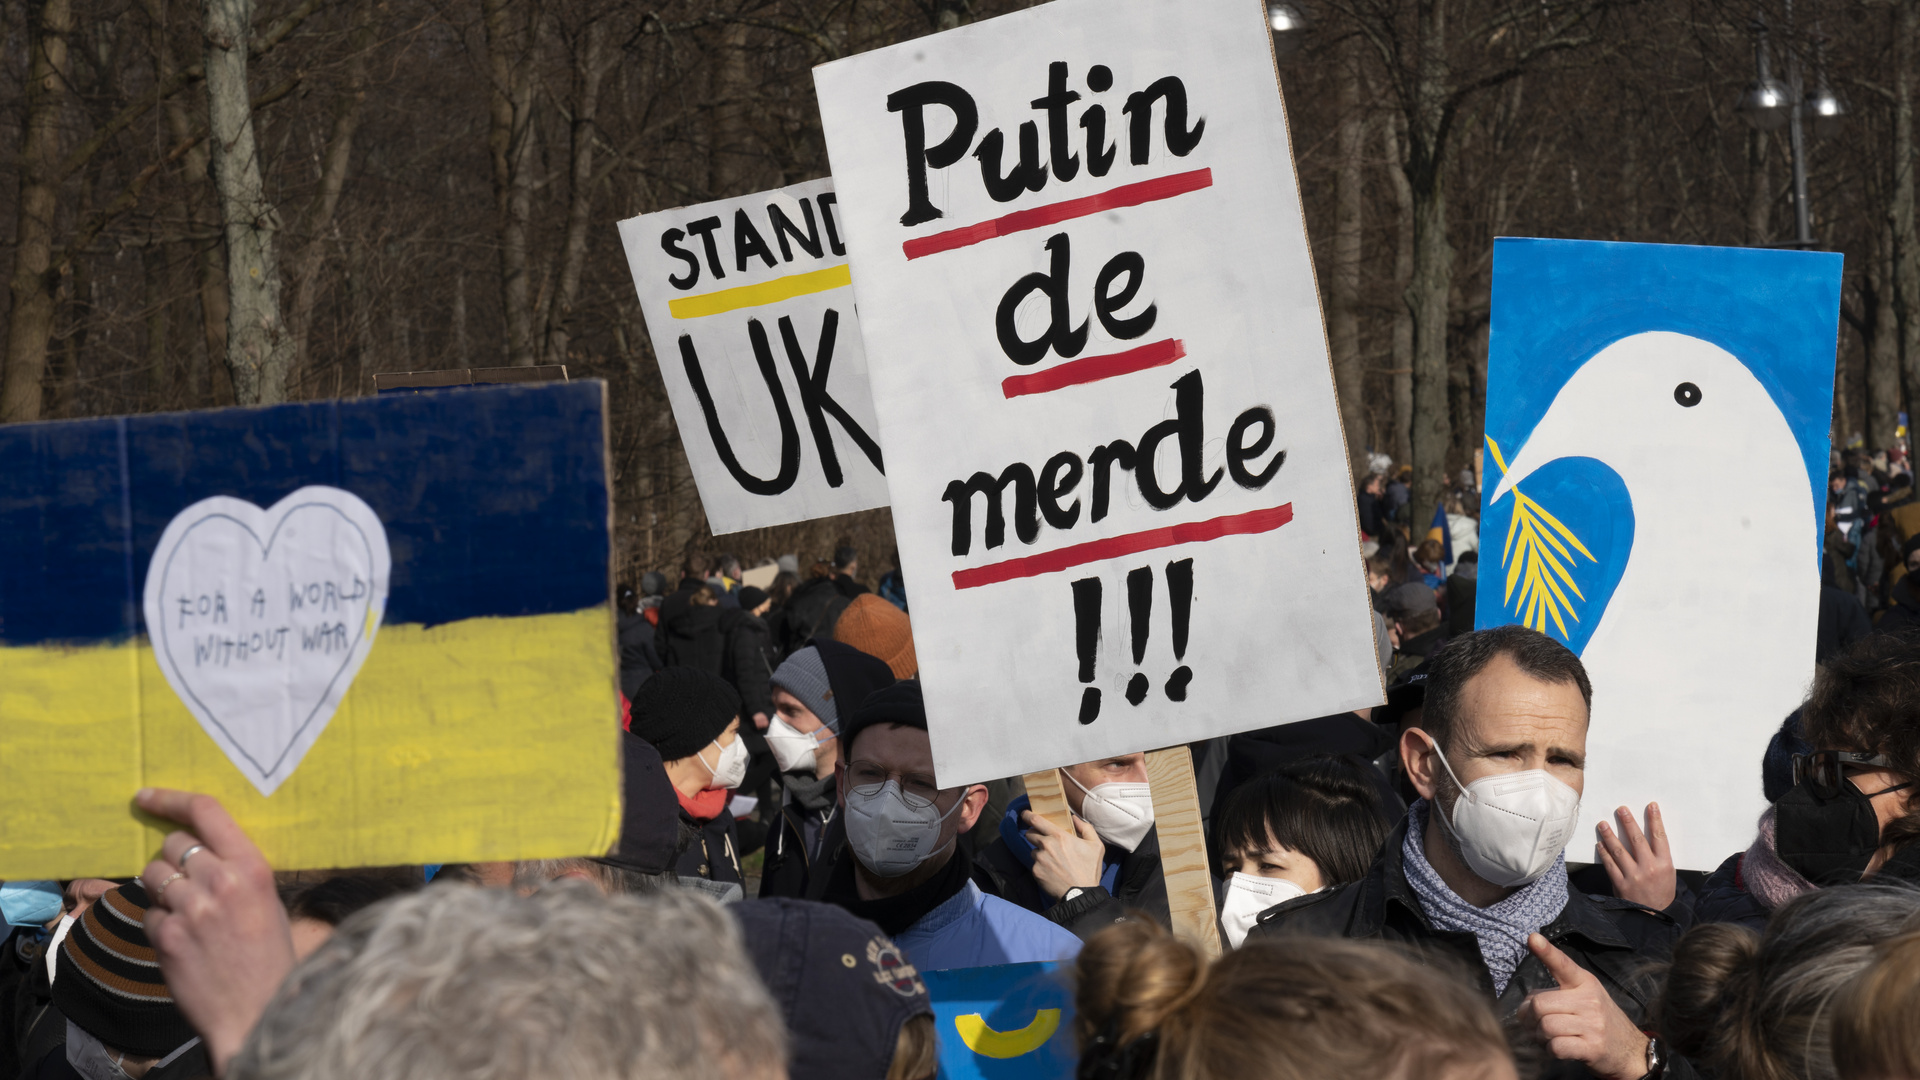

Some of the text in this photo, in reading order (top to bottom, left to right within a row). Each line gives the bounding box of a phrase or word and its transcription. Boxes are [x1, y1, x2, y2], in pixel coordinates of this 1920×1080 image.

[887, 61, 1207, 227] Putin
[995, 232, 1158, 366] de
[677, 305, 886, 496] UK
[941, 368, 1287, 557] merde
[177, 574, 367, 630] FOR A WORLD
[193, 620, 350, 668] WITHOUT WAR
[1071, 557, 1194, 725] !!!
